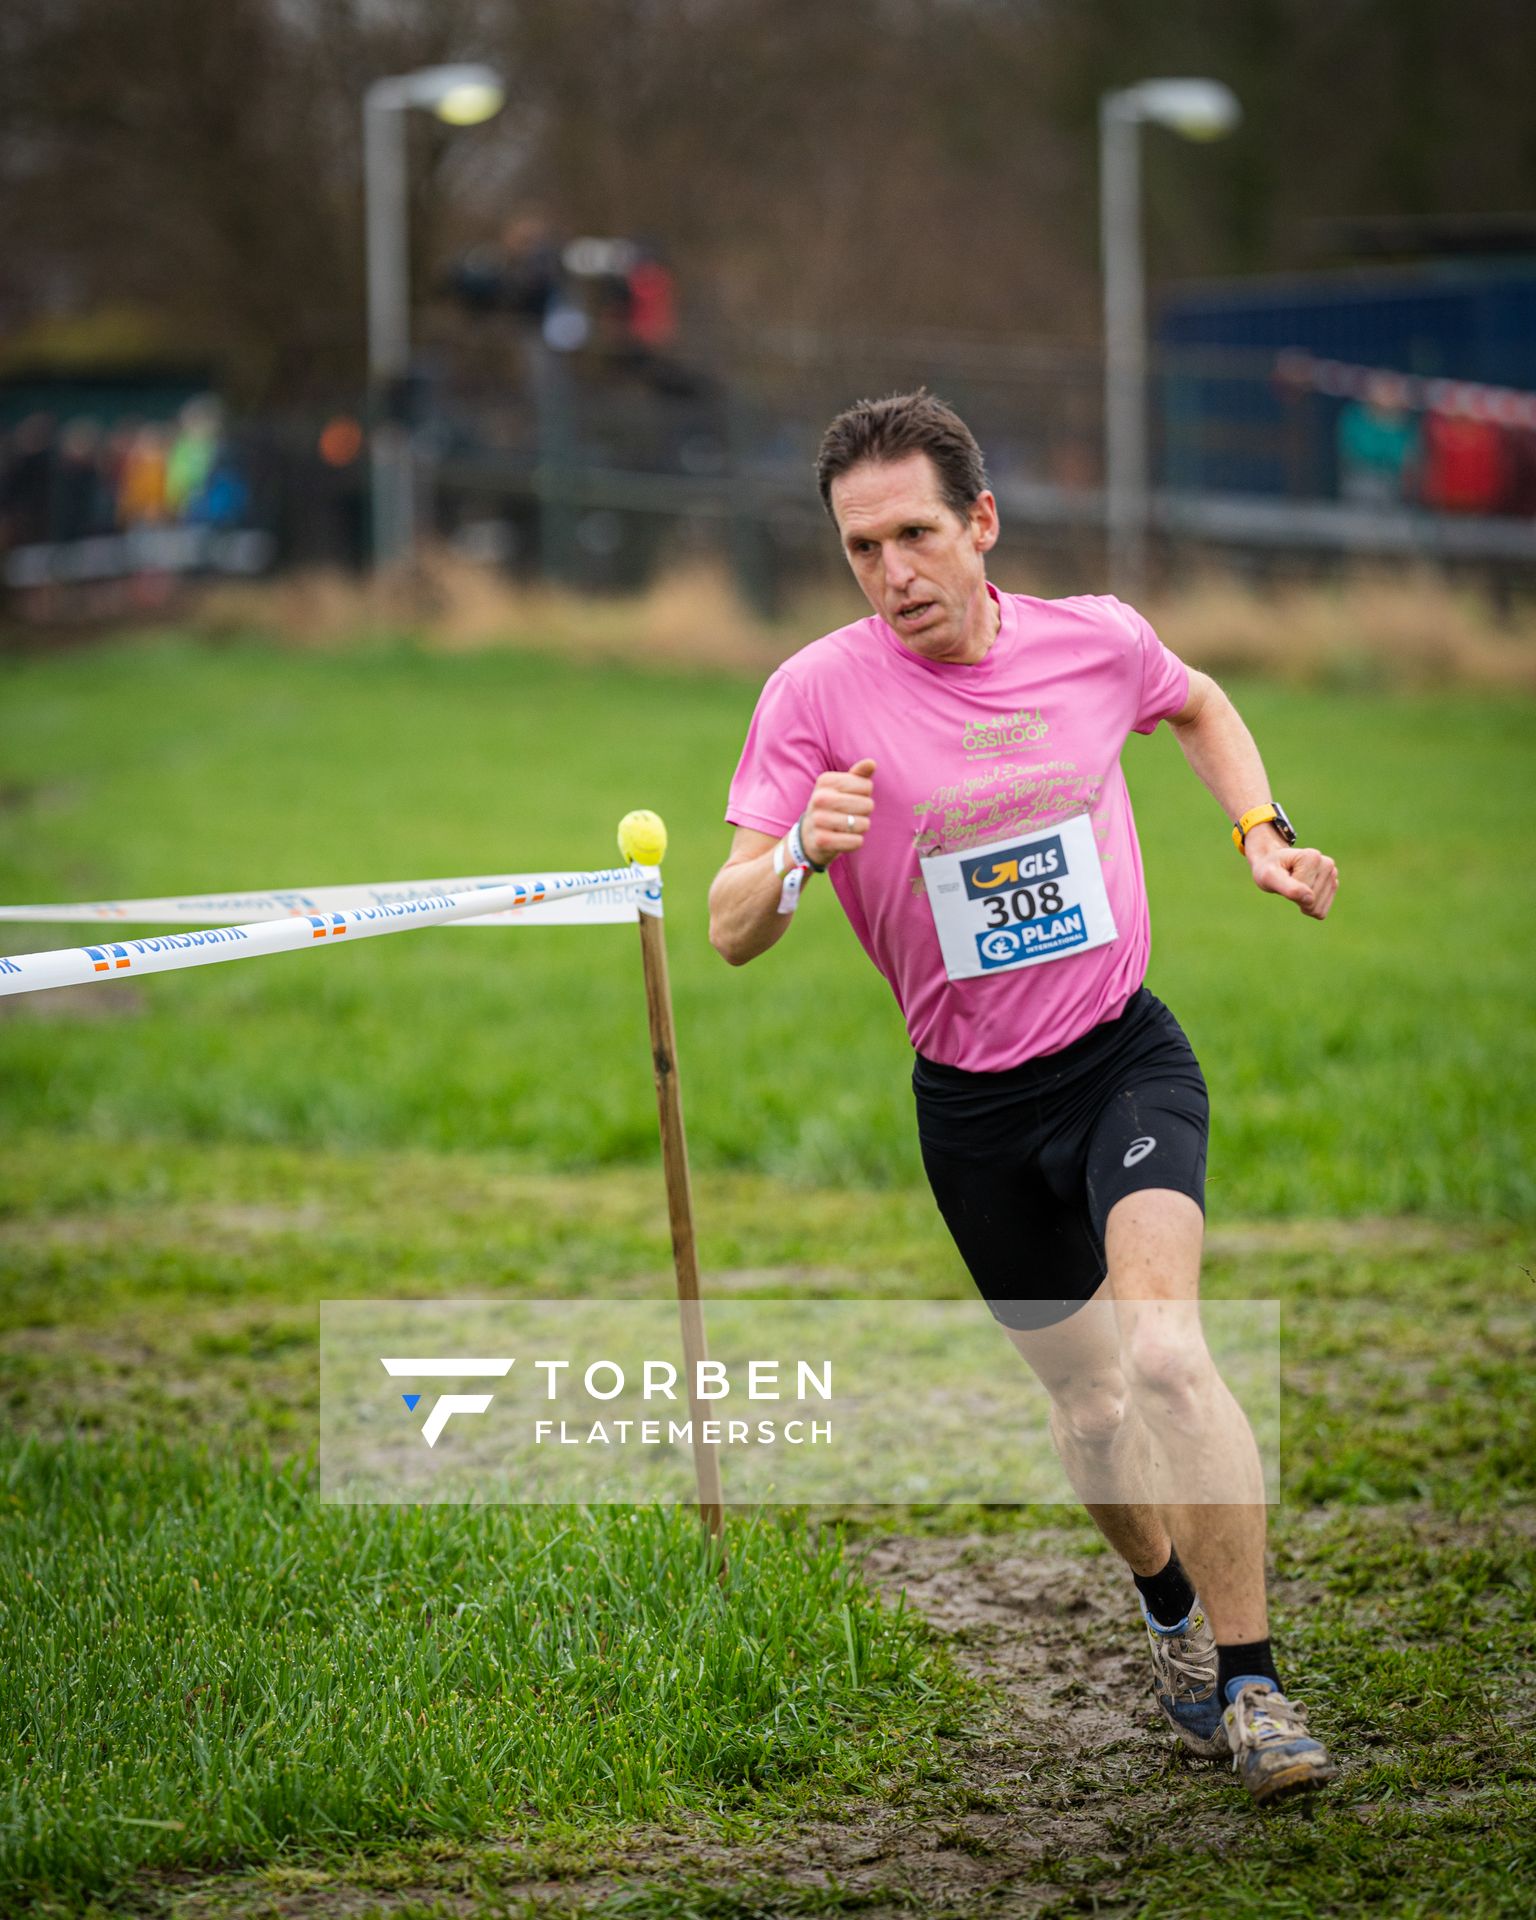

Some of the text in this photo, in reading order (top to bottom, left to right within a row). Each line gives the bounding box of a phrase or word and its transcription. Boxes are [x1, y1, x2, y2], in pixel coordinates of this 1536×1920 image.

[962, 723, 1049, 750] OSSILOOP
[1018, 849, 1059, 879] GLS
[983, 882, 1064, 928] 308
[1021, 913, 1082, 945] PLAN
[1026, 933, 1083, 953] INTERNATIONAL
